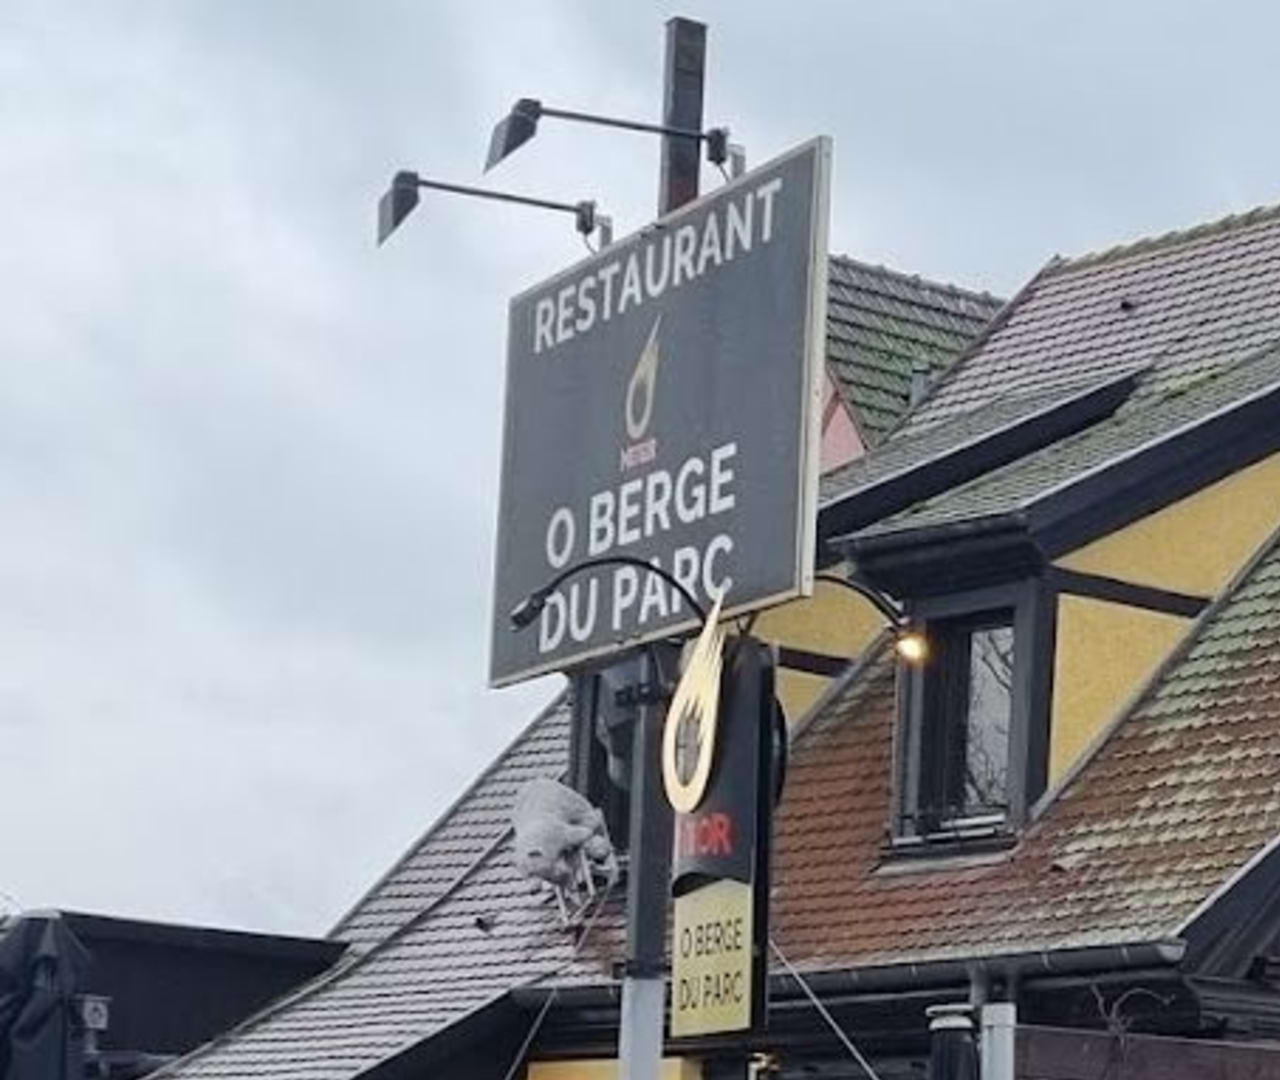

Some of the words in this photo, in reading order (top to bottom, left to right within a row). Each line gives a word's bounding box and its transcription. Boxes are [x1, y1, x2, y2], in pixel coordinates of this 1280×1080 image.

[533, 179, 783, 353] RESTAURANT
[546, 507, 575, 568] O
[588, 442, 738, 557] BERGE
[538, 576, 597, 653] DU
[612, 534, 735, 630] PARC
[679, 976, 698, 1012] DU
[703, 971, 744, 1005] PARC
[681, 926, 693, 958] O
[696, 918, 744, 955] BERGE
